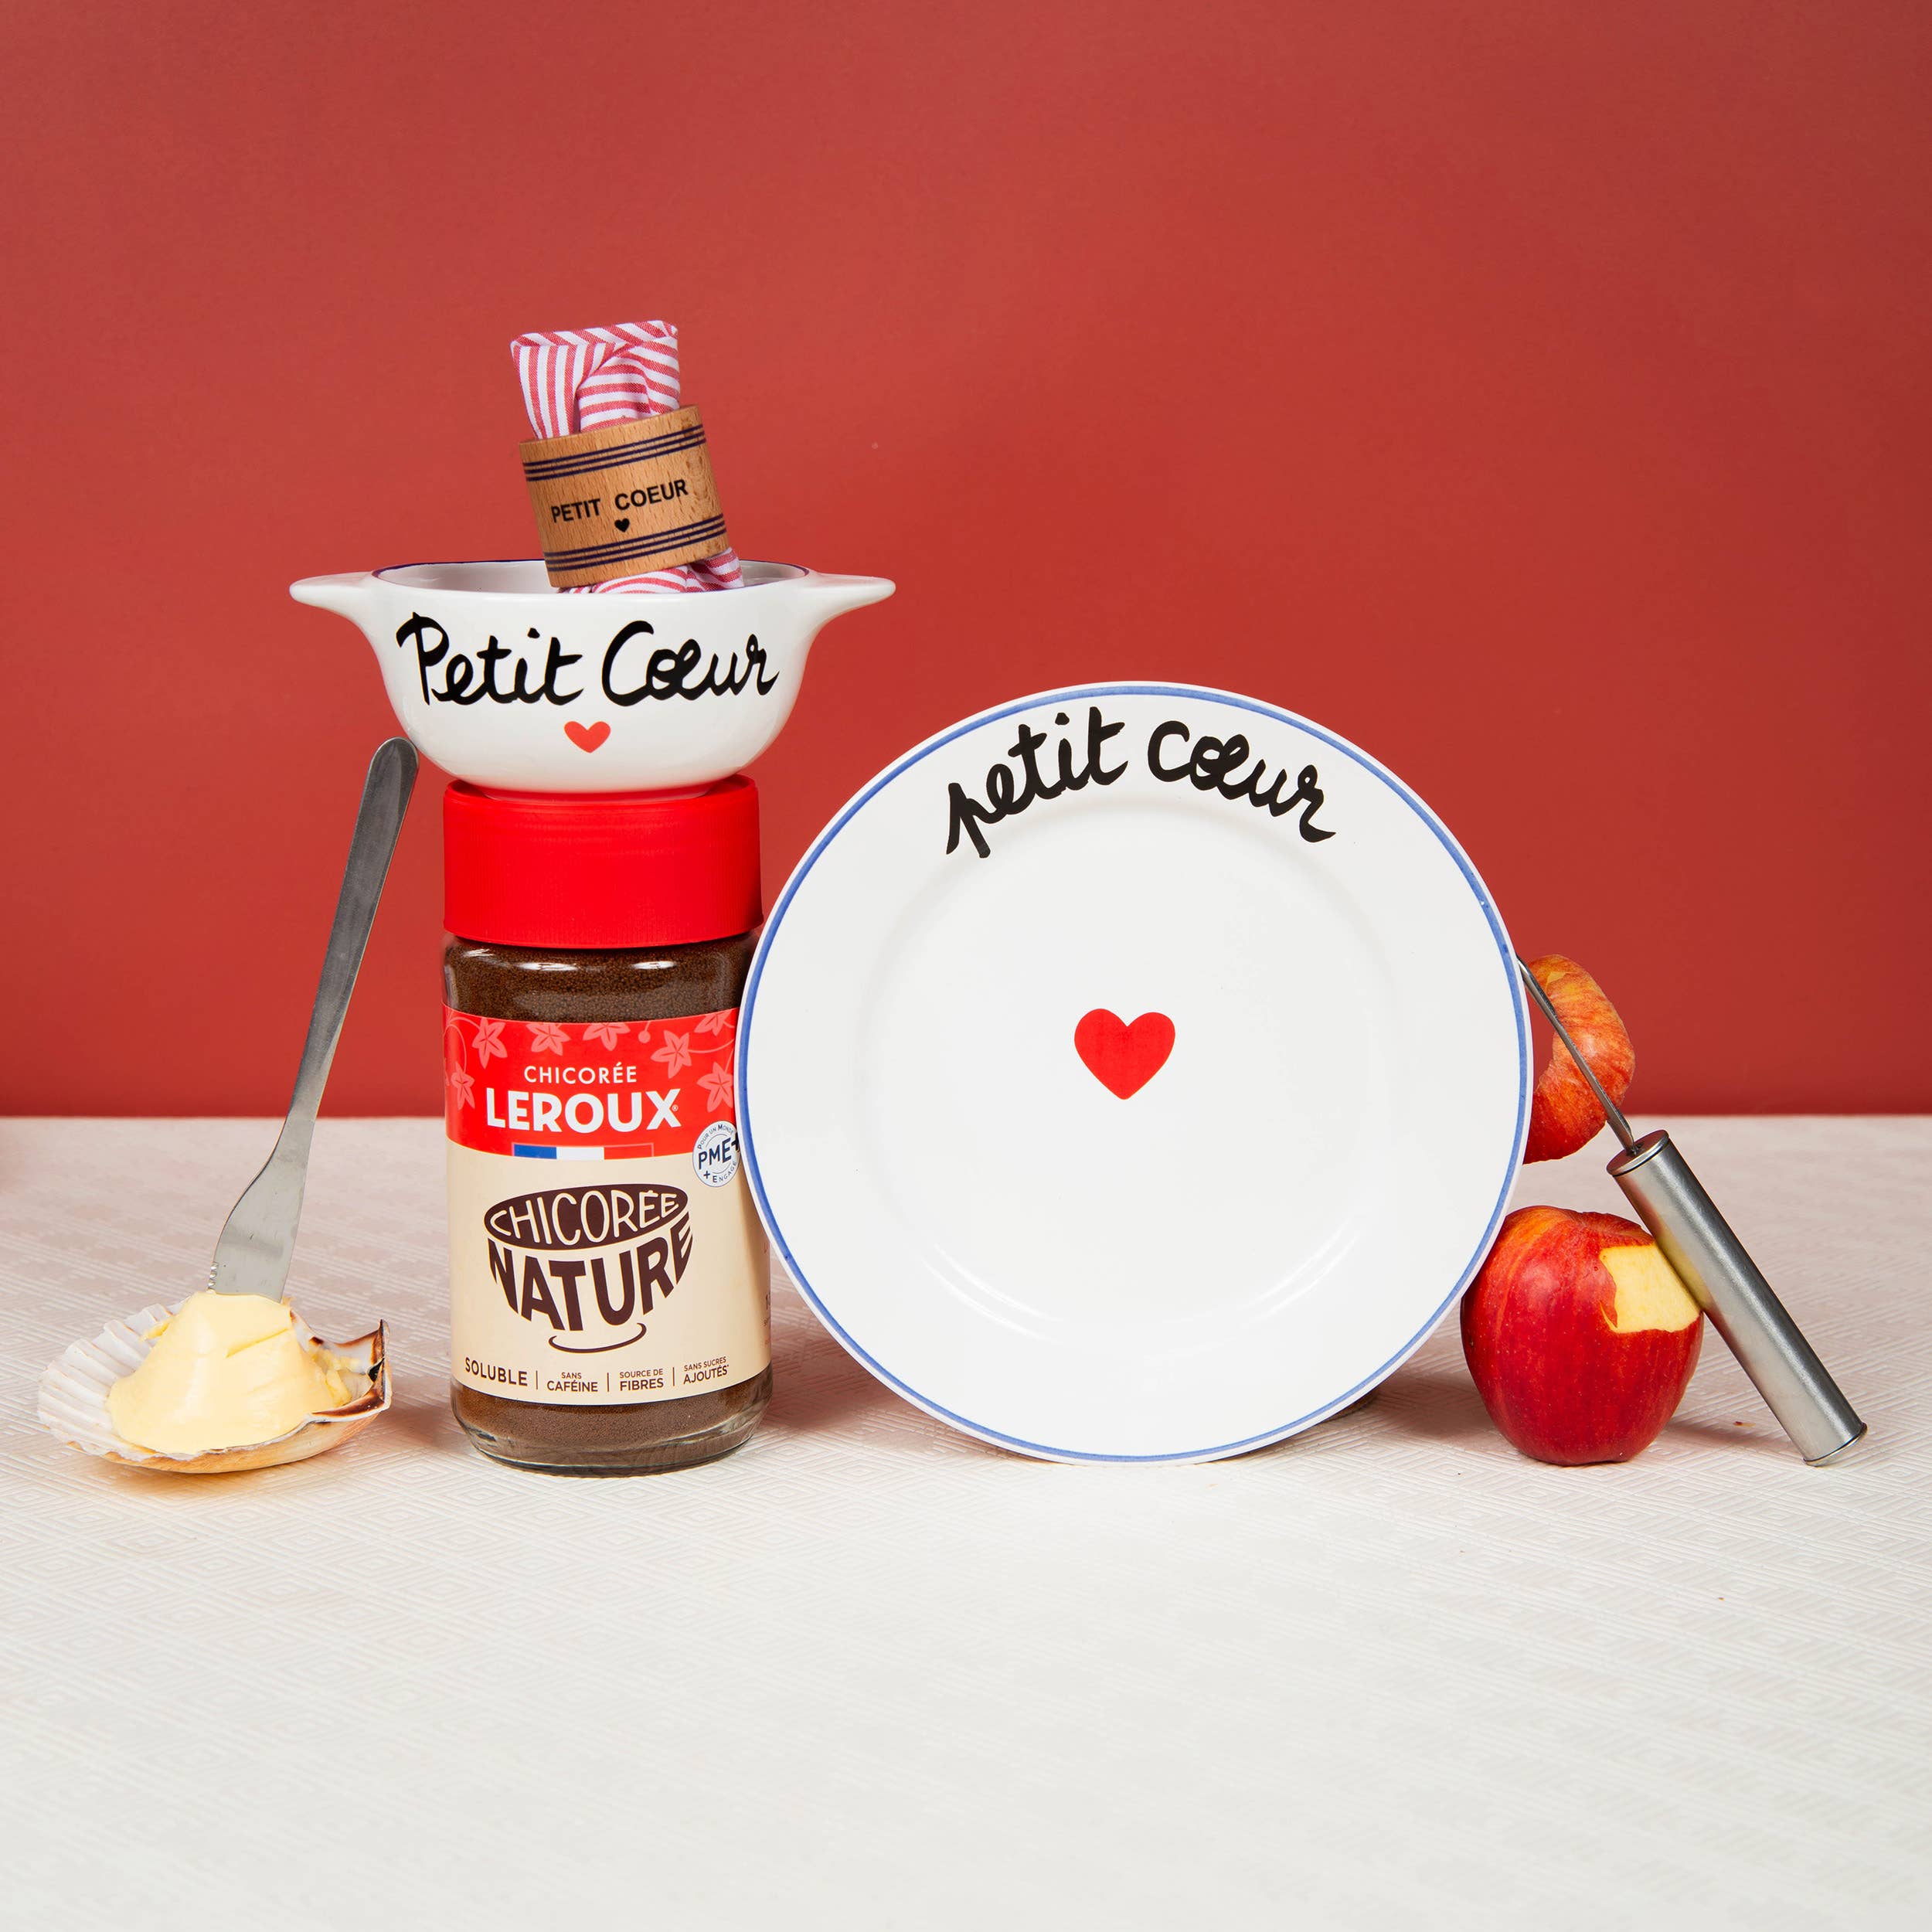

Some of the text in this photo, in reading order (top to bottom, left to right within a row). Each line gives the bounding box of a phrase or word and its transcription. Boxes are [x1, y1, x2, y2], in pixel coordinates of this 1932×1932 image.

[551, 479, 689, 522] PETIT COEUR
[396, 612, 583, 705] Petit
[946, 706, 1128, 859] petit
[524, 1062, 637, 1084] CHICORÉE
[697, 1133, 709, 1150] POUR
[489, 1189, 680, 1245] CHICORÉE
[488, 1211, 693, 1332] NATURE
[464, 1357, 528, 1386] SOLUBLE
[620, 1370, 651, 1379] SOURCE
[684, 1356, 726, 1372] SANS SUCRES
[546, 1379, 598, 1392] CAFÉINE
[620, 1378, 664, 1391] FIBRES
